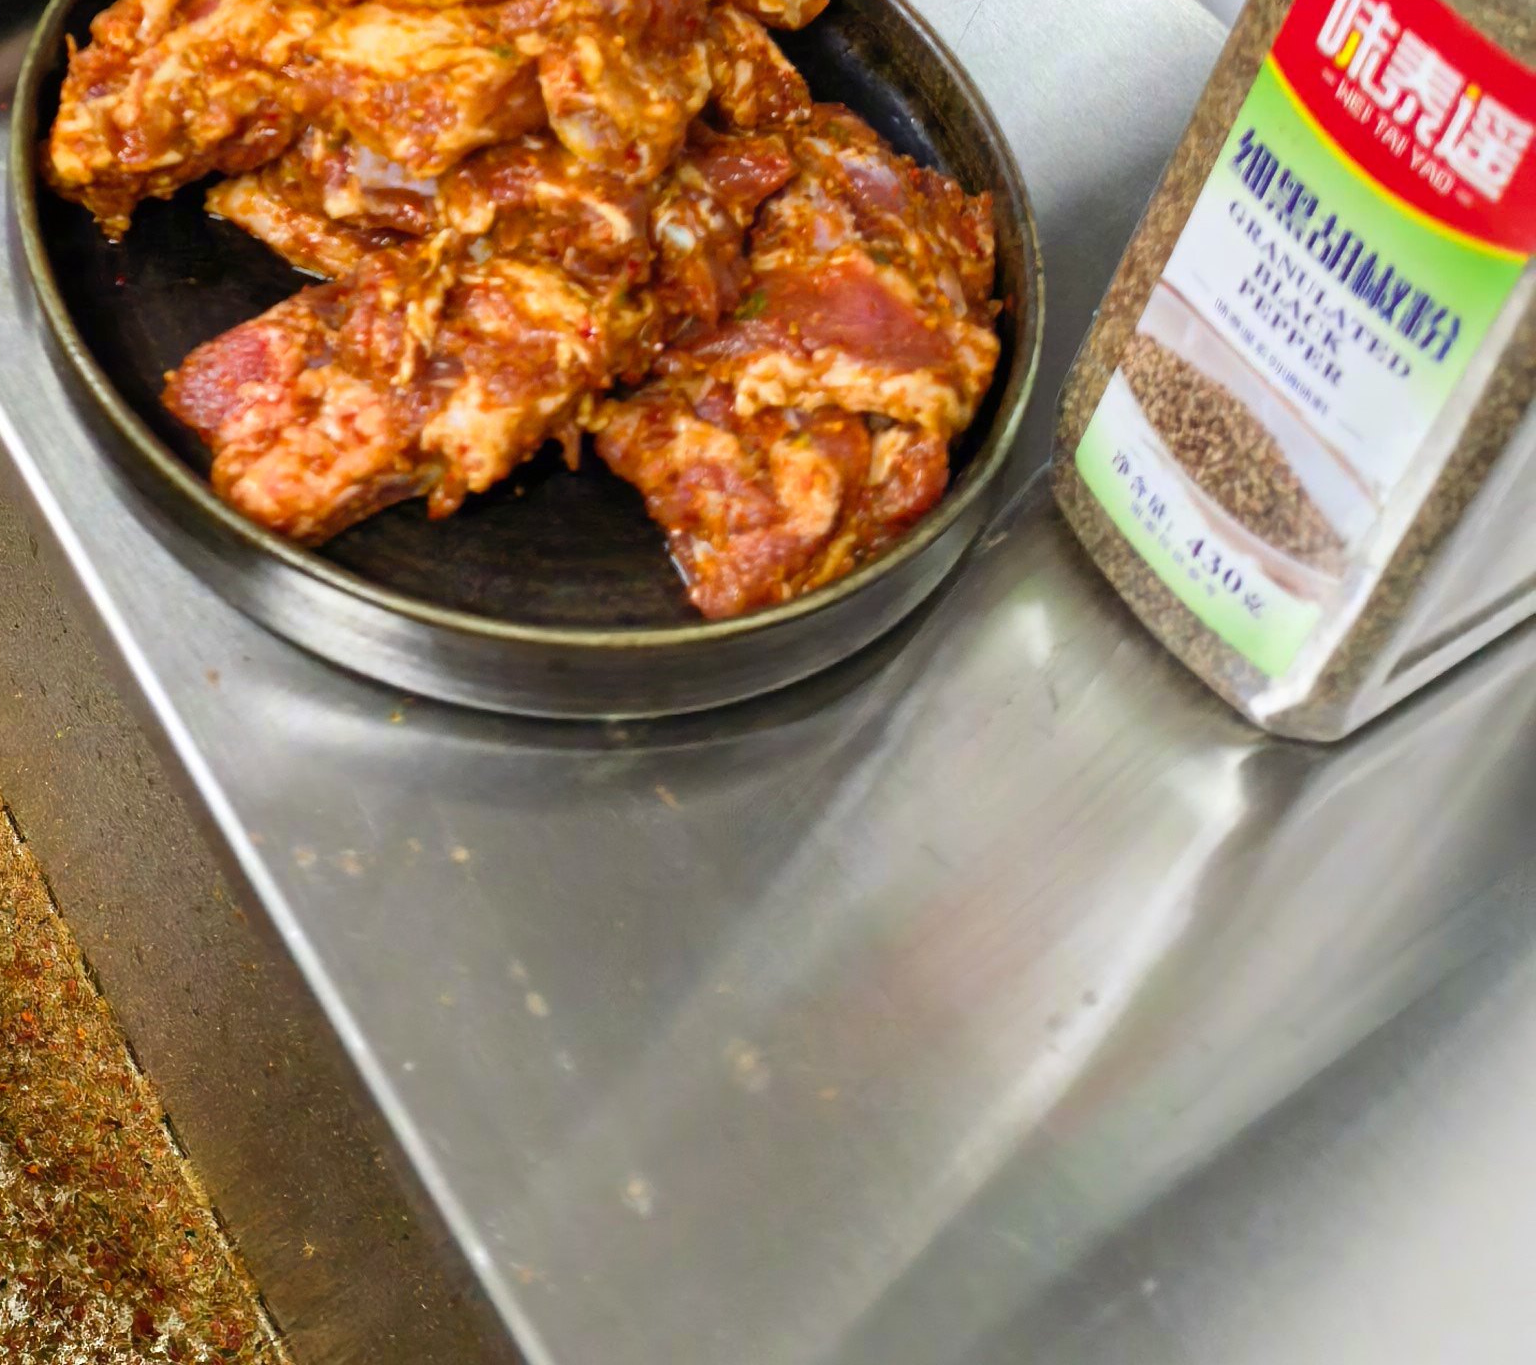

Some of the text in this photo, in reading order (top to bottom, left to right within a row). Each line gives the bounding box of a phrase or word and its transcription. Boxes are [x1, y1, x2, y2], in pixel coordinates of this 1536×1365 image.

[1334, 79, 1457, 197] WEI TAI YAO
[1229, 199, 1411, 379] GRANULATED
[1231, 126, 1462, 364] 细黑胡椒粉
[1238, 278, 1344, 388] PEPPER
[1253, 261, 1341, 356] BLACK
